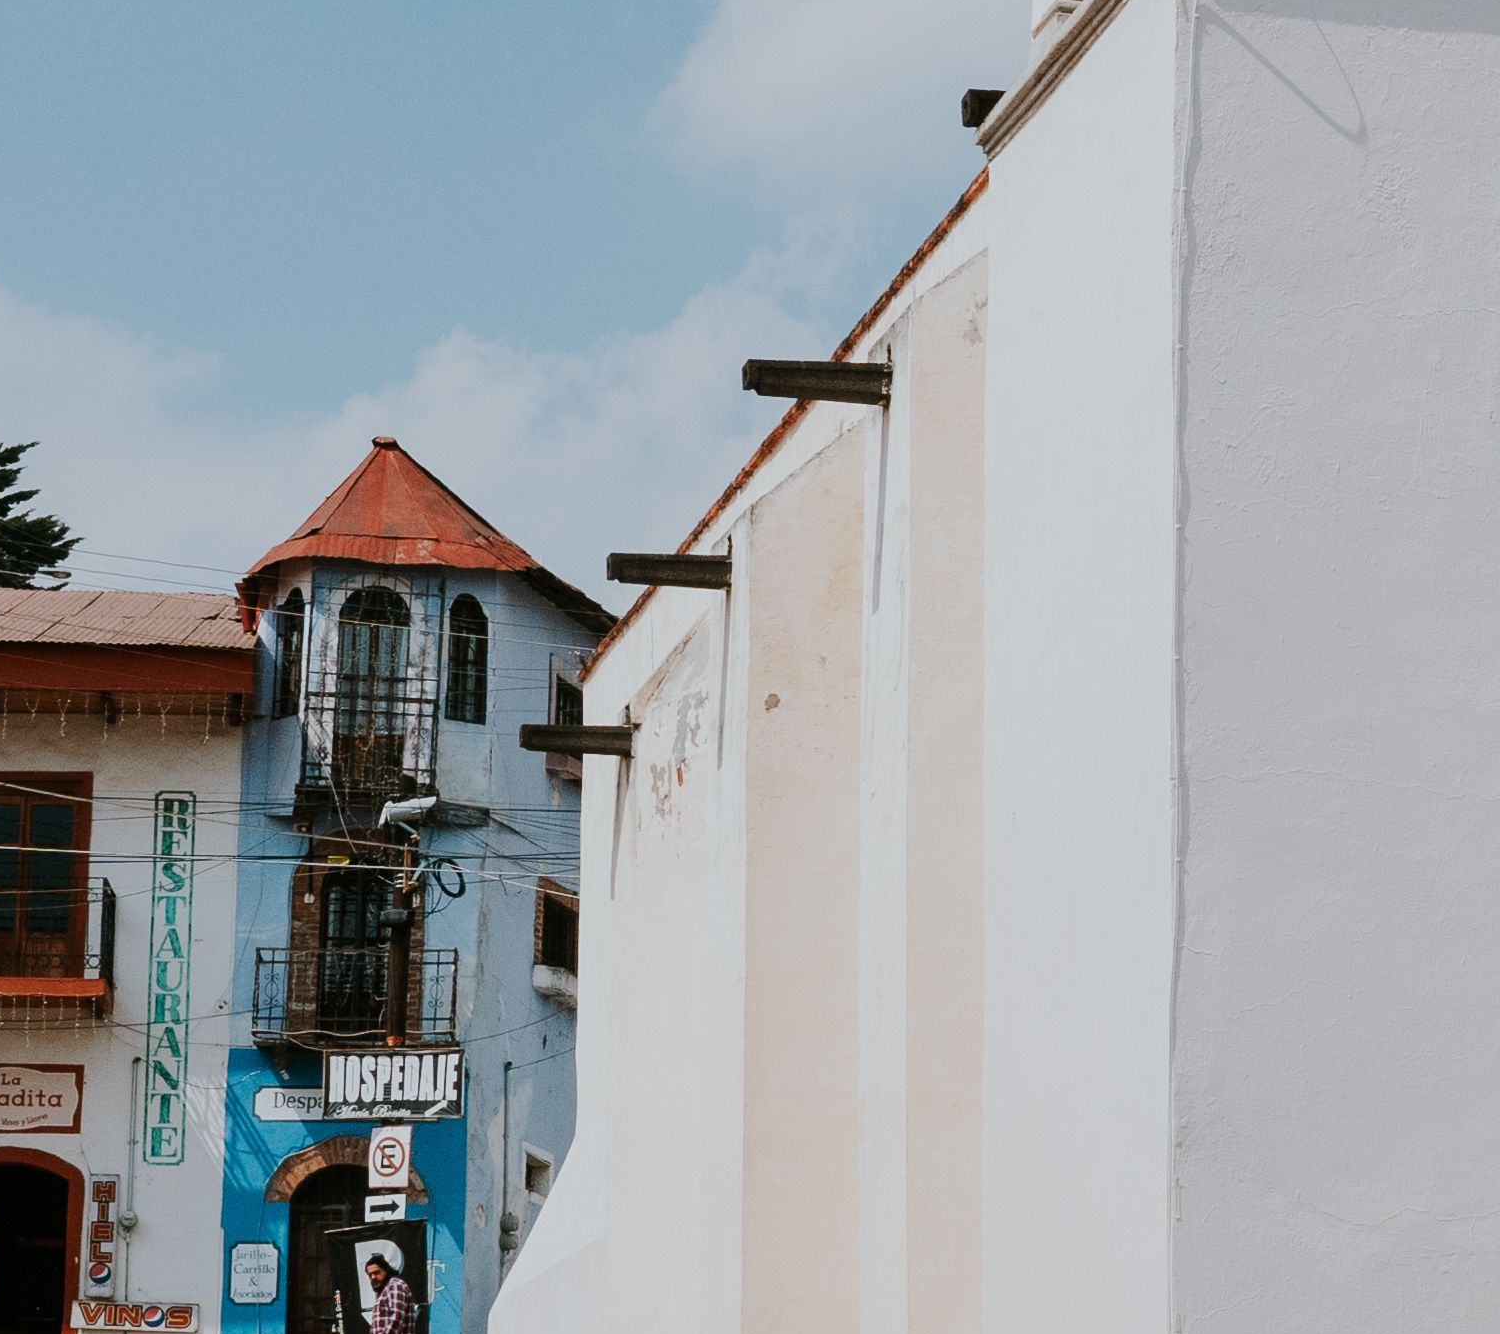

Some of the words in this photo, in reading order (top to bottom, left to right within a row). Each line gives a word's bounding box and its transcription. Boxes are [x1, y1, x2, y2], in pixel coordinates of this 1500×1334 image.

[150, 798, 190, 1158] RESTAURANTE
[0, 1073, 22, 1086] La
[329, 1053, 460, 1103] HOSPEDAJE
[273, 1091, 324, 1115] Despa
[233, 1263, 276, 1275] Carrillo
